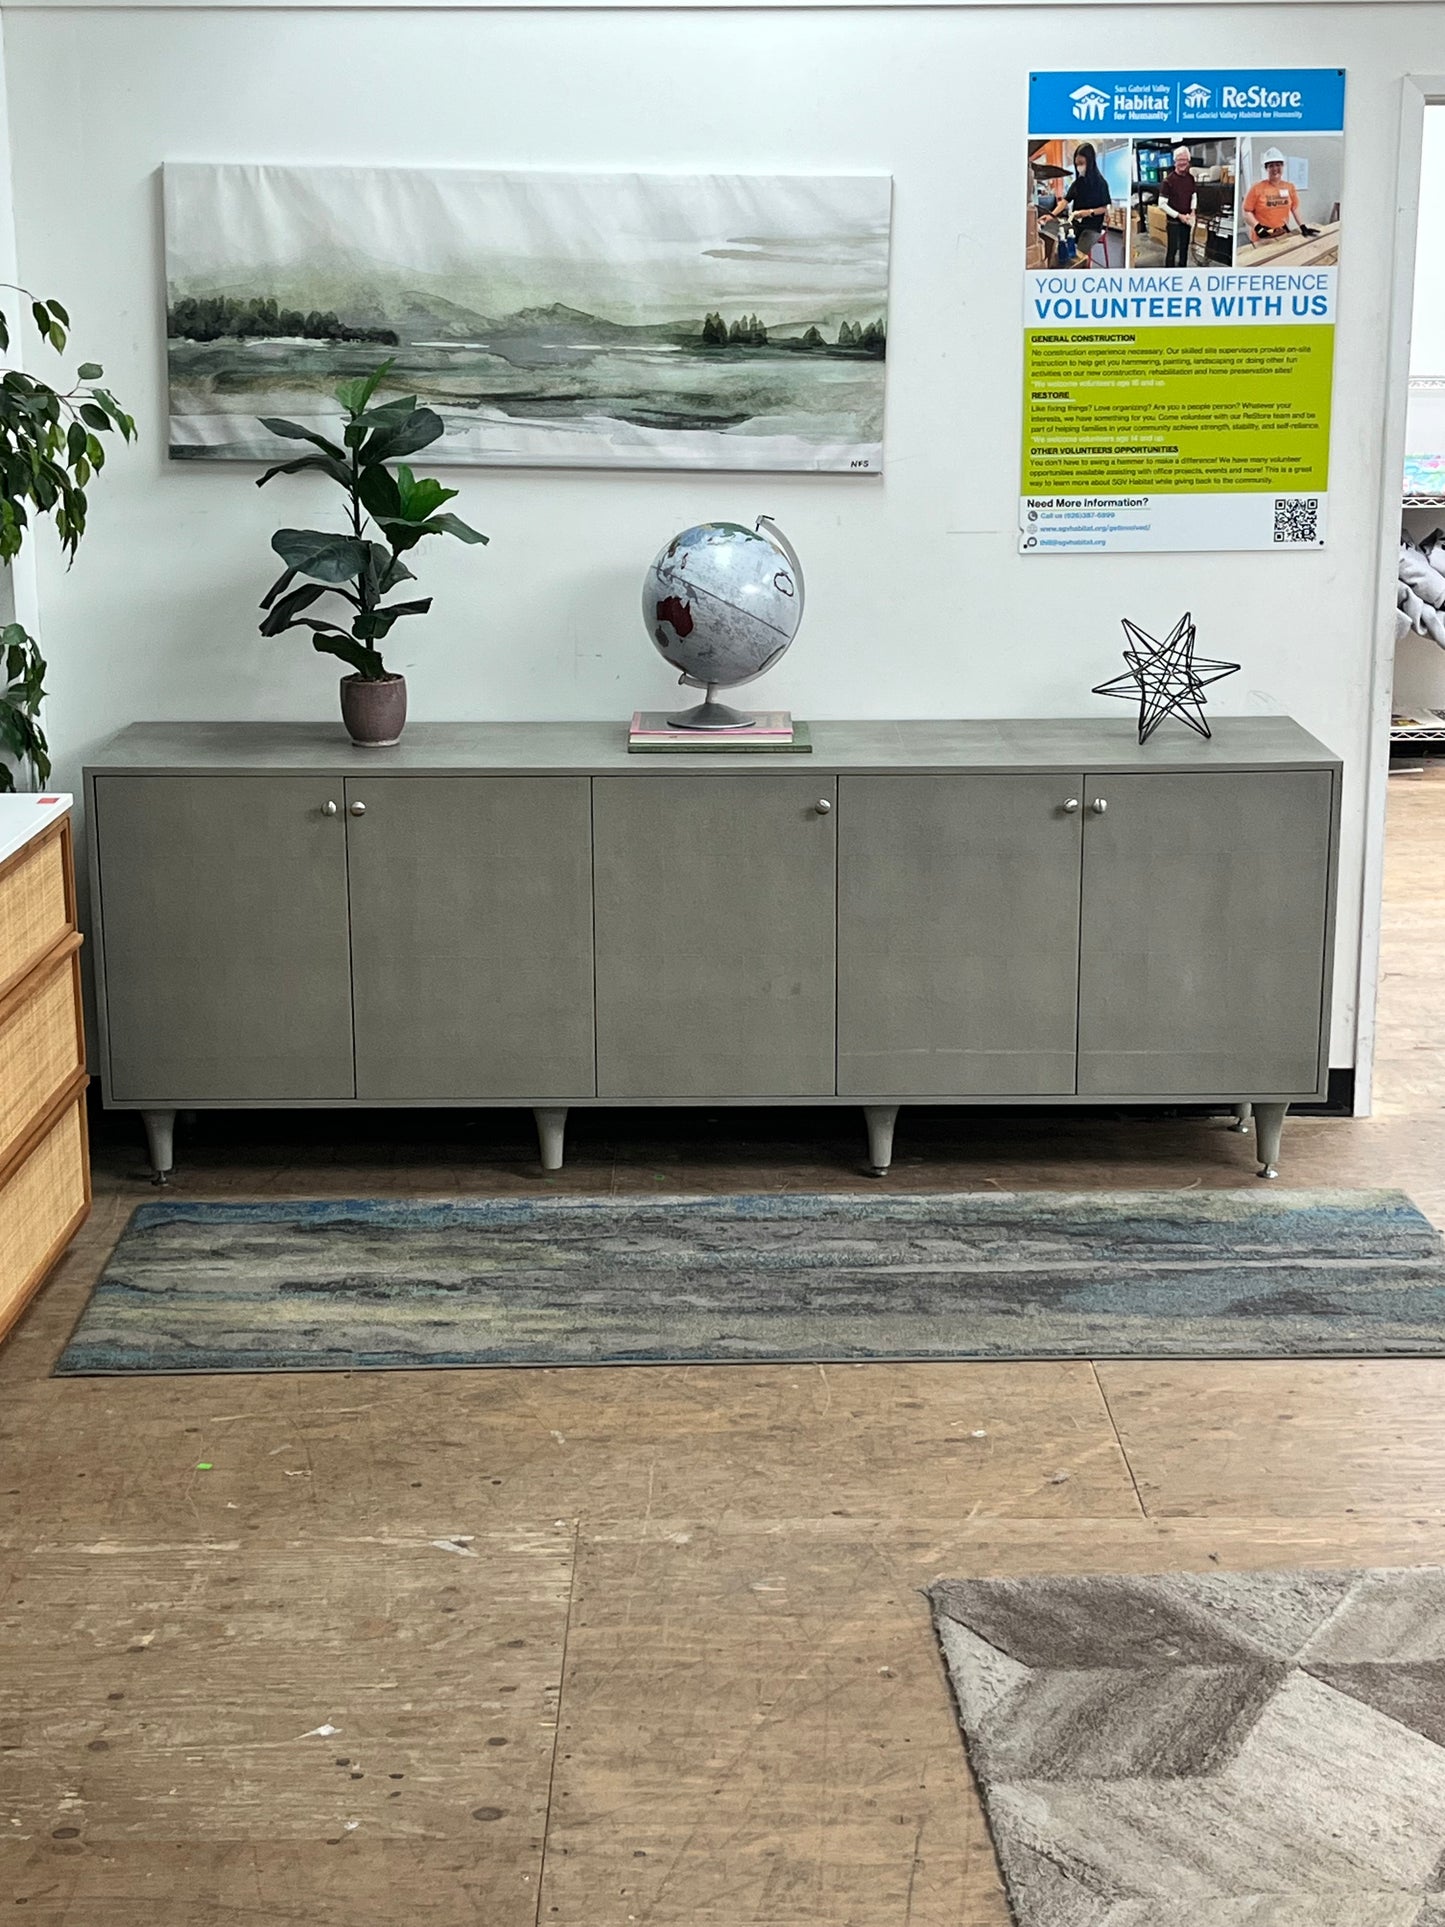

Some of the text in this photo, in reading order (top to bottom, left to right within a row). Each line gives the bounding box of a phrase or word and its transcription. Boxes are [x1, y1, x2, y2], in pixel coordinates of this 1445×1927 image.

[1128, 85, 1150, 93] Gabriel
[1152, 84, 1170, 94] Valley
[1222, 86, 1302, 108] ReStore
[1114, 95, 1169, 110] Habitat
[1114, 111, 1168, 121] for Humanity
[1220, 111, 1238, 120] Valley
[1273, 111, 1302, 119] Humanity
[1036, 274, 1328, 294] YOU CAN MAKE A DIFFERENCE
[1035, 295, 1328, 319] VOLUNTEER WITH US
[1088, 348, 1126, 357] experience
[1218, 346, 1258, 355] supervisors
[1260, 346, 1285, 355] provide
[1078, 359, 1093, 367] help
[1094, 358, 1106, 367] get
[1122, 358, 1161, 367] hammering,
[1194, 357, 1235, 366] landscaping
[1246, 356, 1264, 365] doing
[1230, 367, 1273, 376] preservation
[1047, 404, 1066, 413] fixing
[1068, 404, 1092, 413] things?
[1113, 403, 1151, 412] organizing?
[1187, 403, 1211, 411] people
[1212, 402, 1240, 411] person?
[1094, 414, 1130, 423] something
[1031, 425, 1045, 434] part
[1055, 425, 1080, 434] helping
[1133, 424, 1170, 433] community
[1090, 458, 1109, 466] swing
[1030, 469, 1074, 478] opportunities
[1106, 468, 1136, 477] assisting
[1294, 466, 1312, 474] great
[1174, 478, 1194, 486] giving
[1027, 498, 1148, 508] Need More Information?
